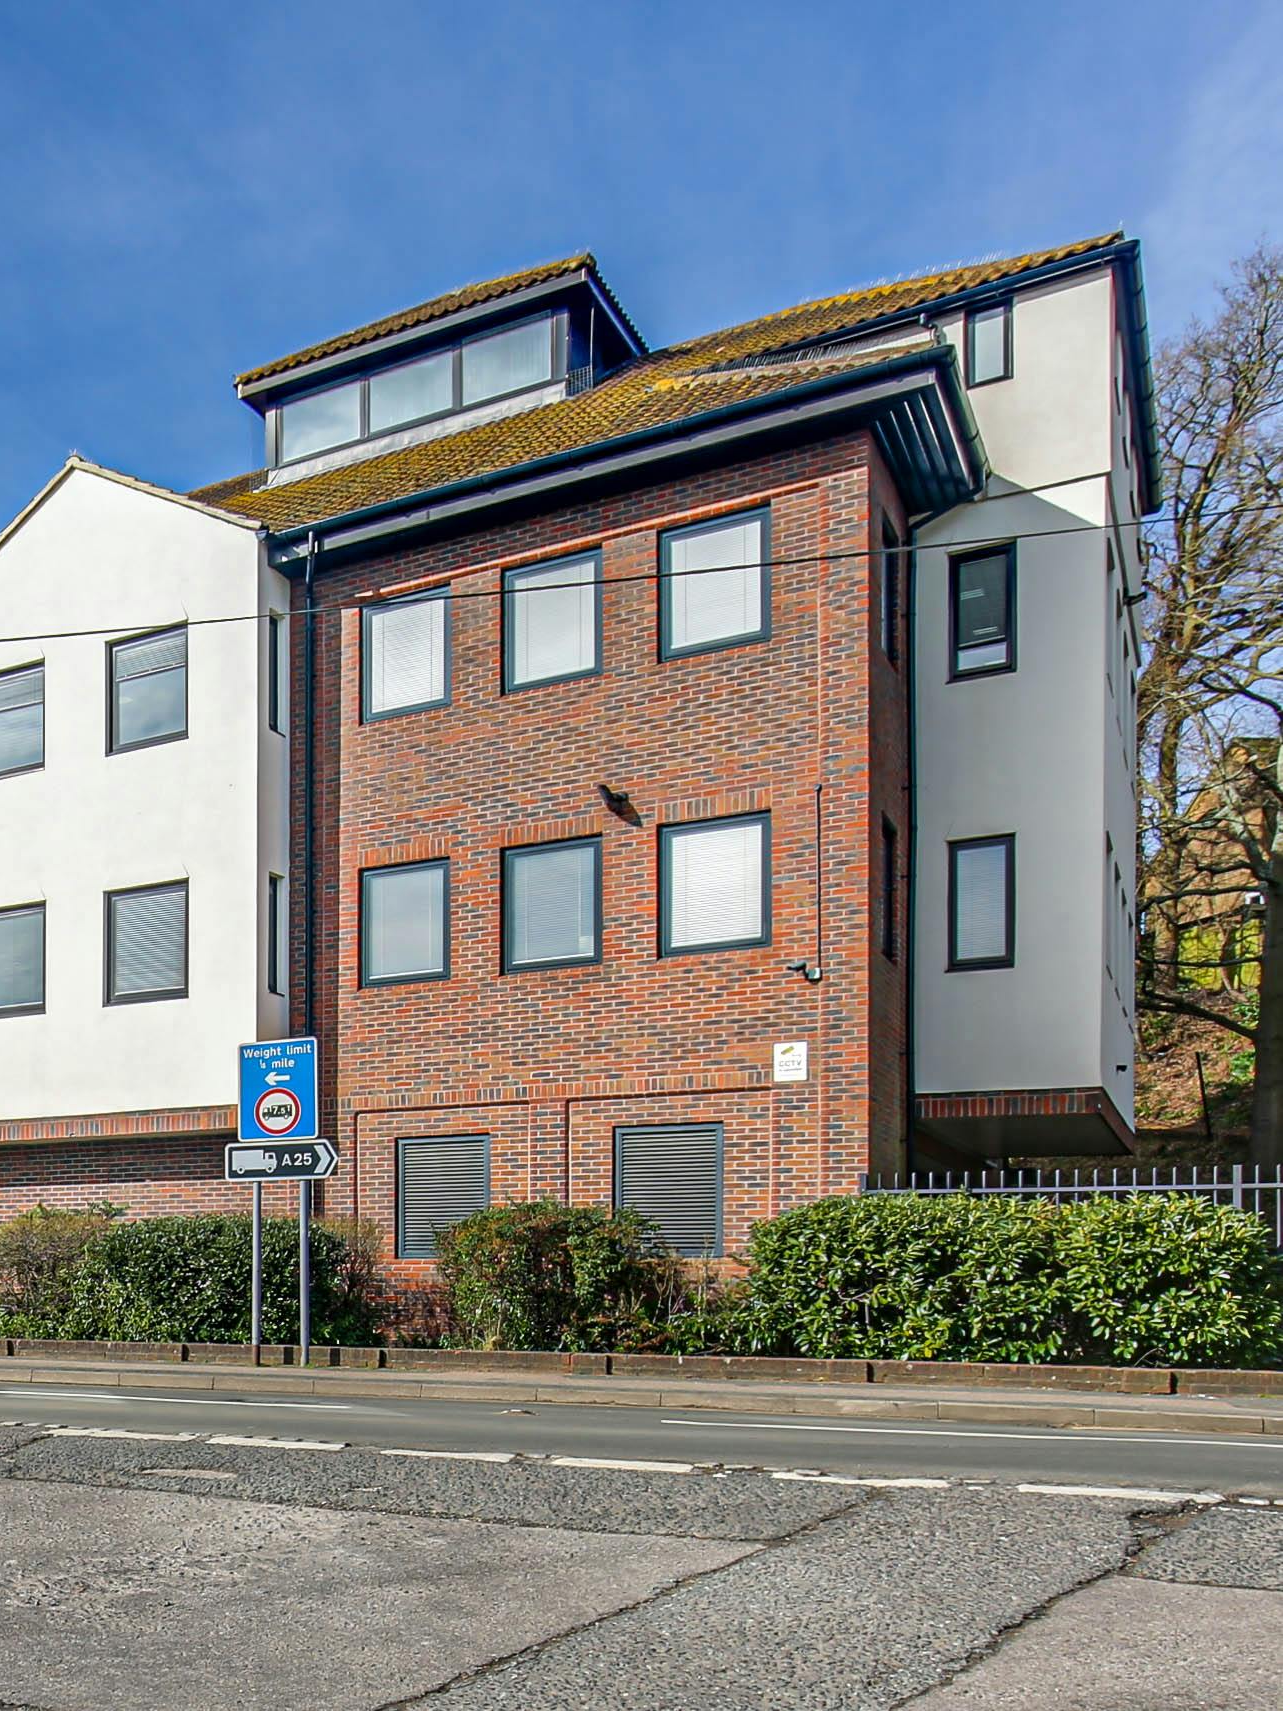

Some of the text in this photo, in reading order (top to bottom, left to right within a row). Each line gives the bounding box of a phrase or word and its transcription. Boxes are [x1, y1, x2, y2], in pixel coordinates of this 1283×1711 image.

[243, 1043, 312, 1059] Weight limit
[271, 1057, 295, 1069] mile
[778, 1059, 802, 1067] CCTV
[281, 1152, 312, 1167] A25
